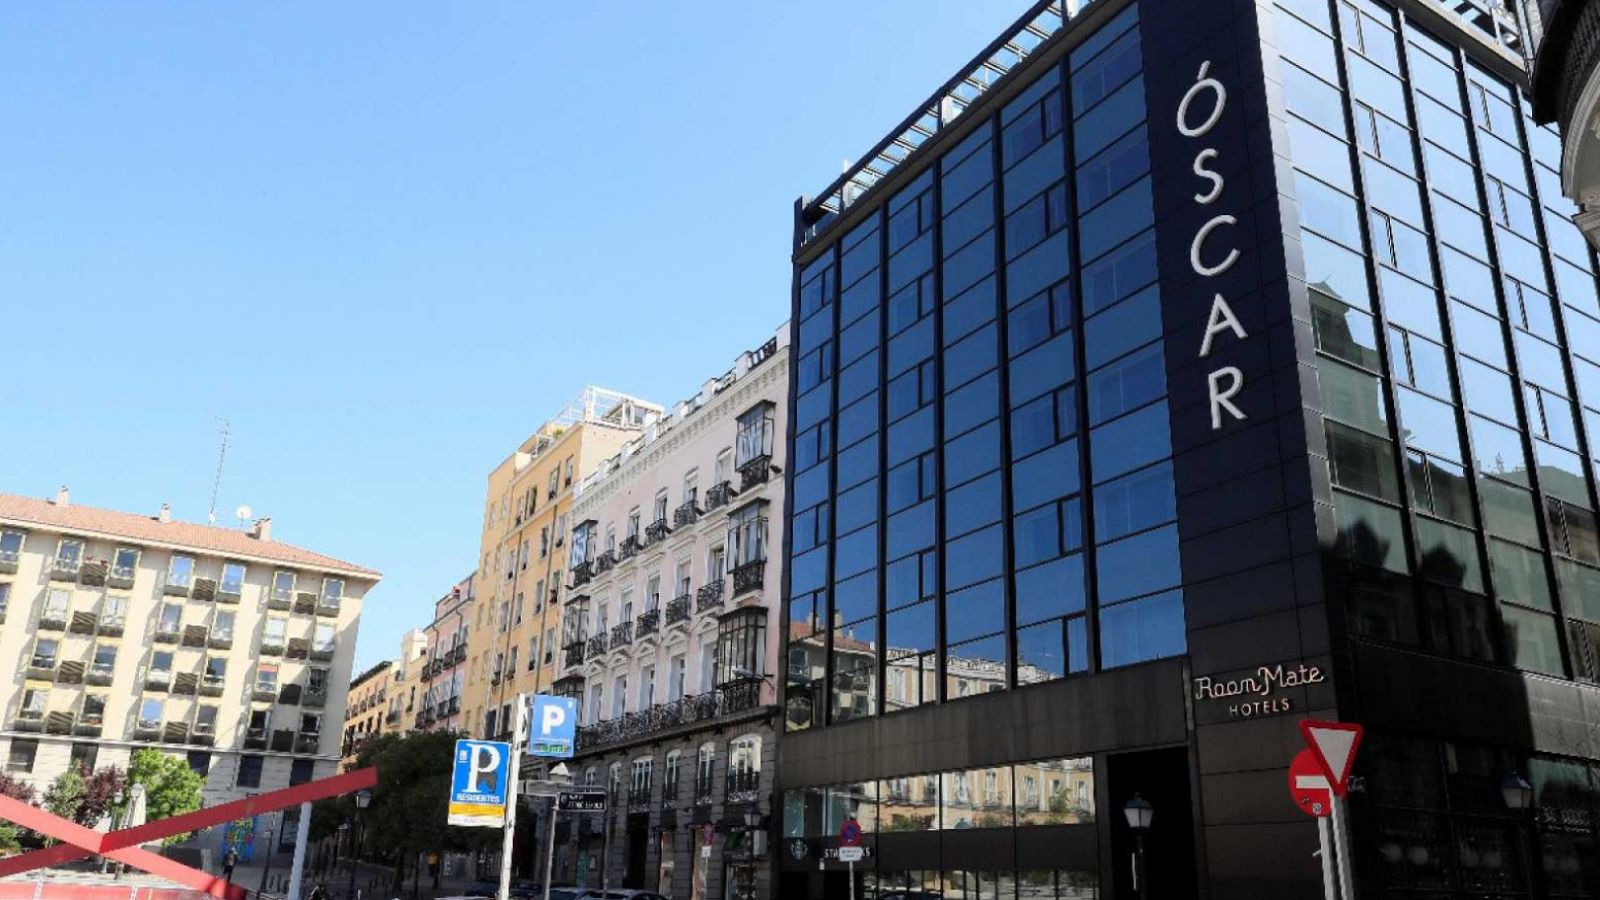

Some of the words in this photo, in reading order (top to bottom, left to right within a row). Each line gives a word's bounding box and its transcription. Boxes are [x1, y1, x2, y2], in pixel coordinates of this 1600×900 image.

[1177, 60, 1249, 431] ÓSCAR
[1195, 676, 1261, 699] Room
[1257, 664, 1324, 696] Mate
[542, 704, 565, 736] P
[1229, 698, 1290, 716] HOTELS
[462, 743, 501, 793] P
